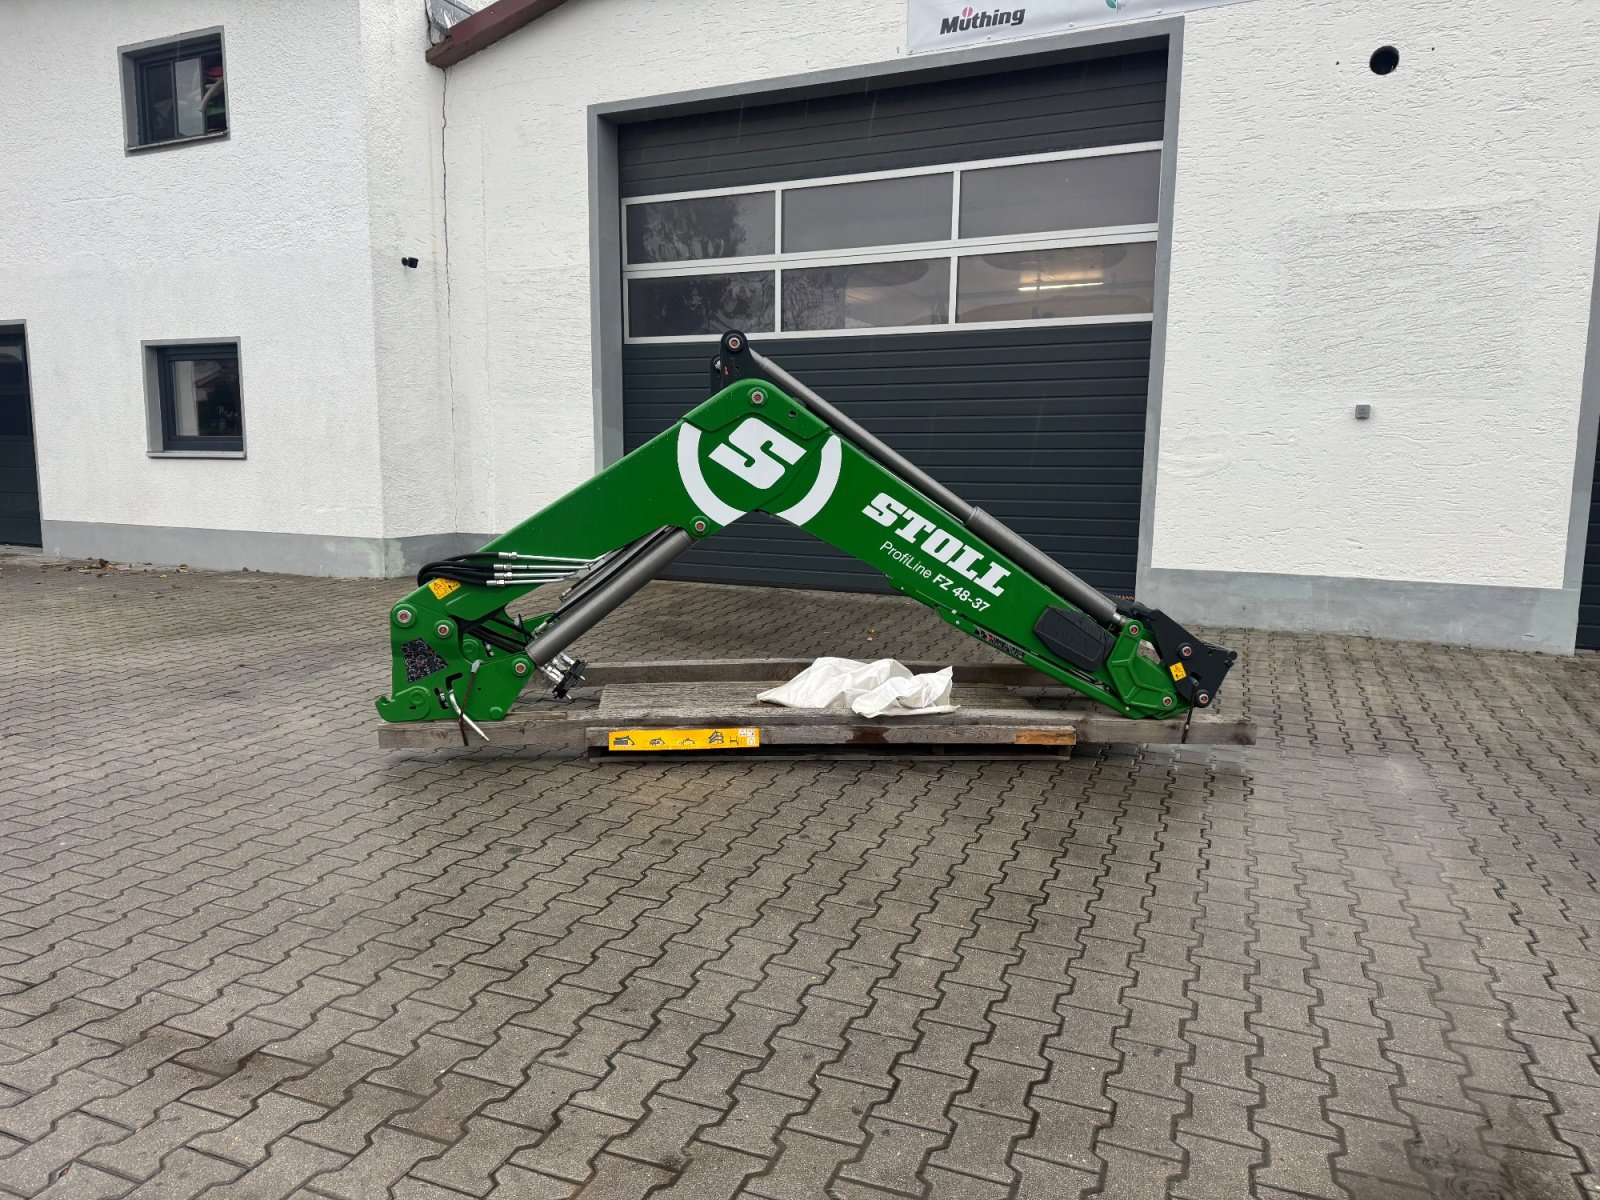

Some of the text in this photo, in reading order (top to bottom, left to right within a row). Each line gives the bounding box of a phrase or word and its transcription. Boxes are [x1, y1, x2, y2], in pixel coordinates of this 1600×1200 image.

[708, 417, 807, 490] S
[861, 492, 1012, 597] STOLL
[879, 540, 991, 612] ProfiLine FZ 48-37
